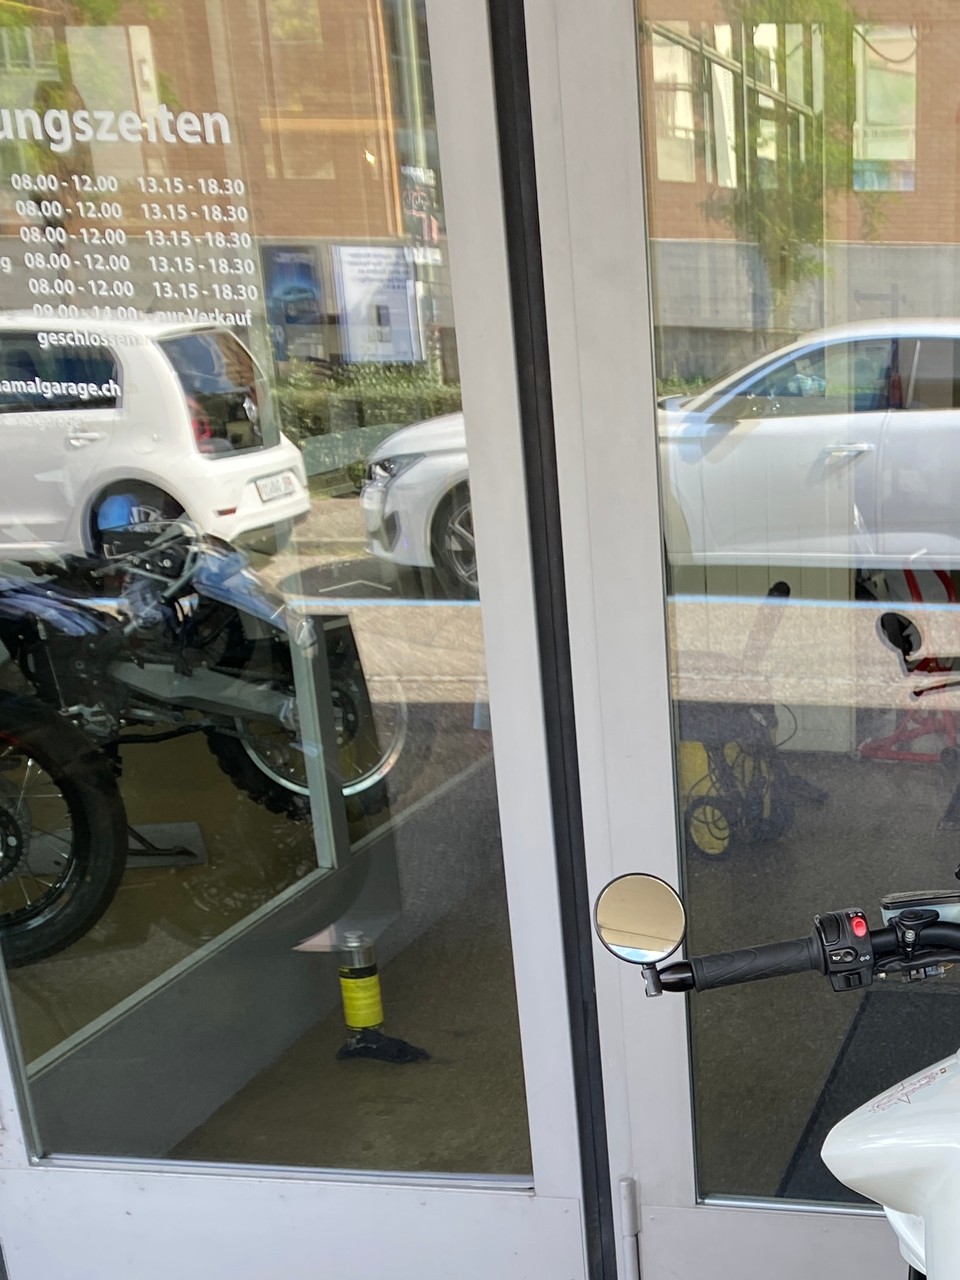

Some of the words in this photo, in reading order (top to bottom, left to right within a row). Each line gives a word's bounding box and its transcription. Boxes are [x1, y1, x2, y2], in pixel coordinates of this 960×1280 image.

[0, 103, 231, 153] ungszeiten
[10, 173, 59, 192] 08.00
[71, 174, 118, 193] 12.00
[137, 176, 184, 195] 13.15
[198, 178, 245, 196] 18.30
[15, 200, 63, 218] 08.00
[76, 201, 122, 219] 12.00
[141, 203, 188, 221] 13.15
[201, 204, 248, 223] 18.30
[20, 226, 67, 244] 08.00
[80, 227, 126, 246] 12.00
[145, 229, 192, 247] 13.15
[205, 231, 252, 249] 18.30
[24, 252, 71, 270] 08.00
[84, 253, 130, 271] 12.00
[148, 256, 196, 273] 13.15
[208, 257, 255, 275] 18.30
[28, 278, 75, 296] 08.00
[88, 279, 134, 297] 12.00
[153, 281, 199, 299] 13.15
[212, 283, 258, 301] 18.30
[32, 303, 79, 319] 0900
[92, 305, 138, 320] 1400
[186, 307, 252, 326] Verkauf
[37, 328, 140, 349] geschlossen
[0, 376, 121, 401] amalgarage.ch
